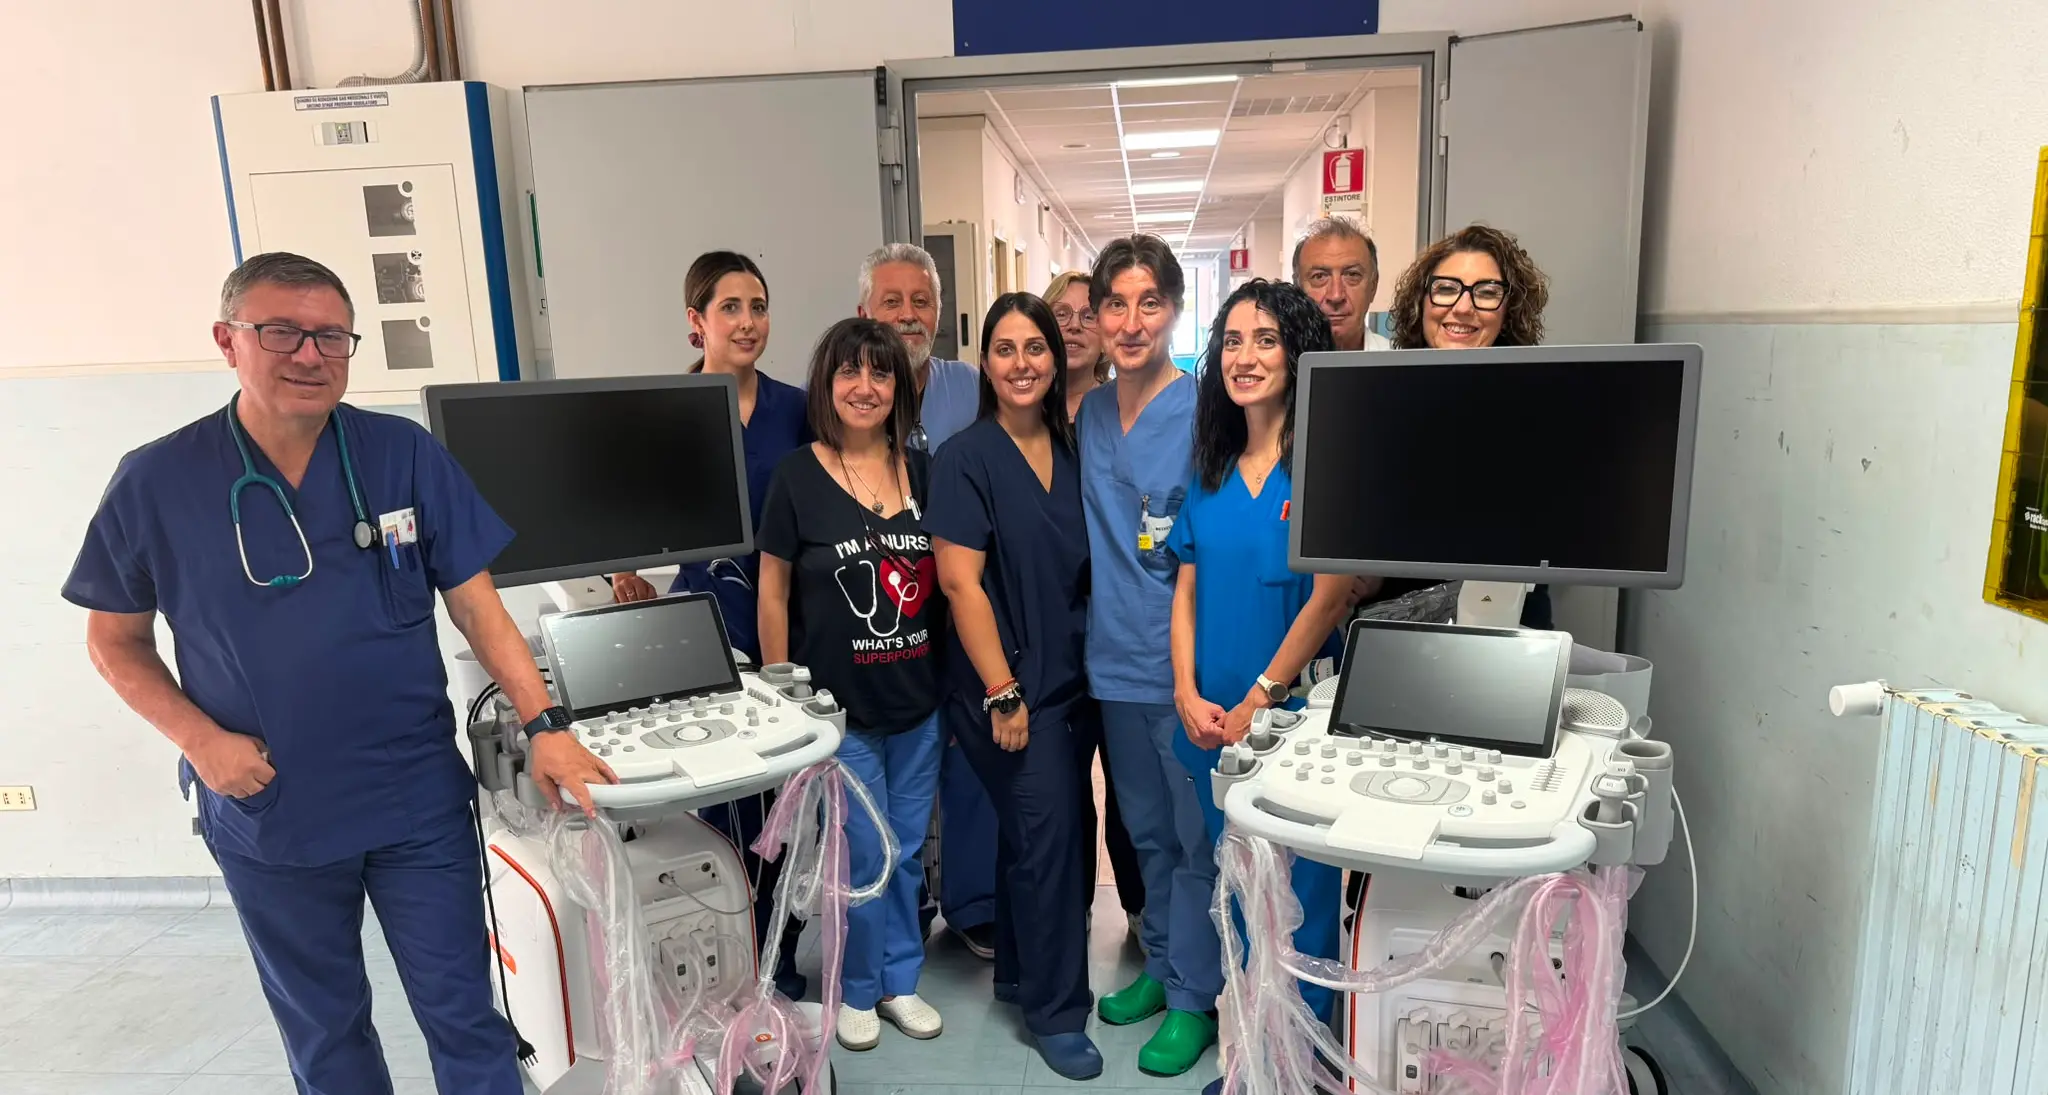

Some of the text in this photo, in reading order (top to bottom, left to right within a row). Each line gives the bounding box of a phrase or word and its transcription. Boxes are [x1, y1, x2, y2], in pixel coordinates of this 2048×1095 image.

[1324, 194, 1361, 203] ESTINTORE
[835, 538, 861, 560] I'M
[880, 534, 933, 551] NURS
[852, 628, 929, 651] WHAT'S YOUR
